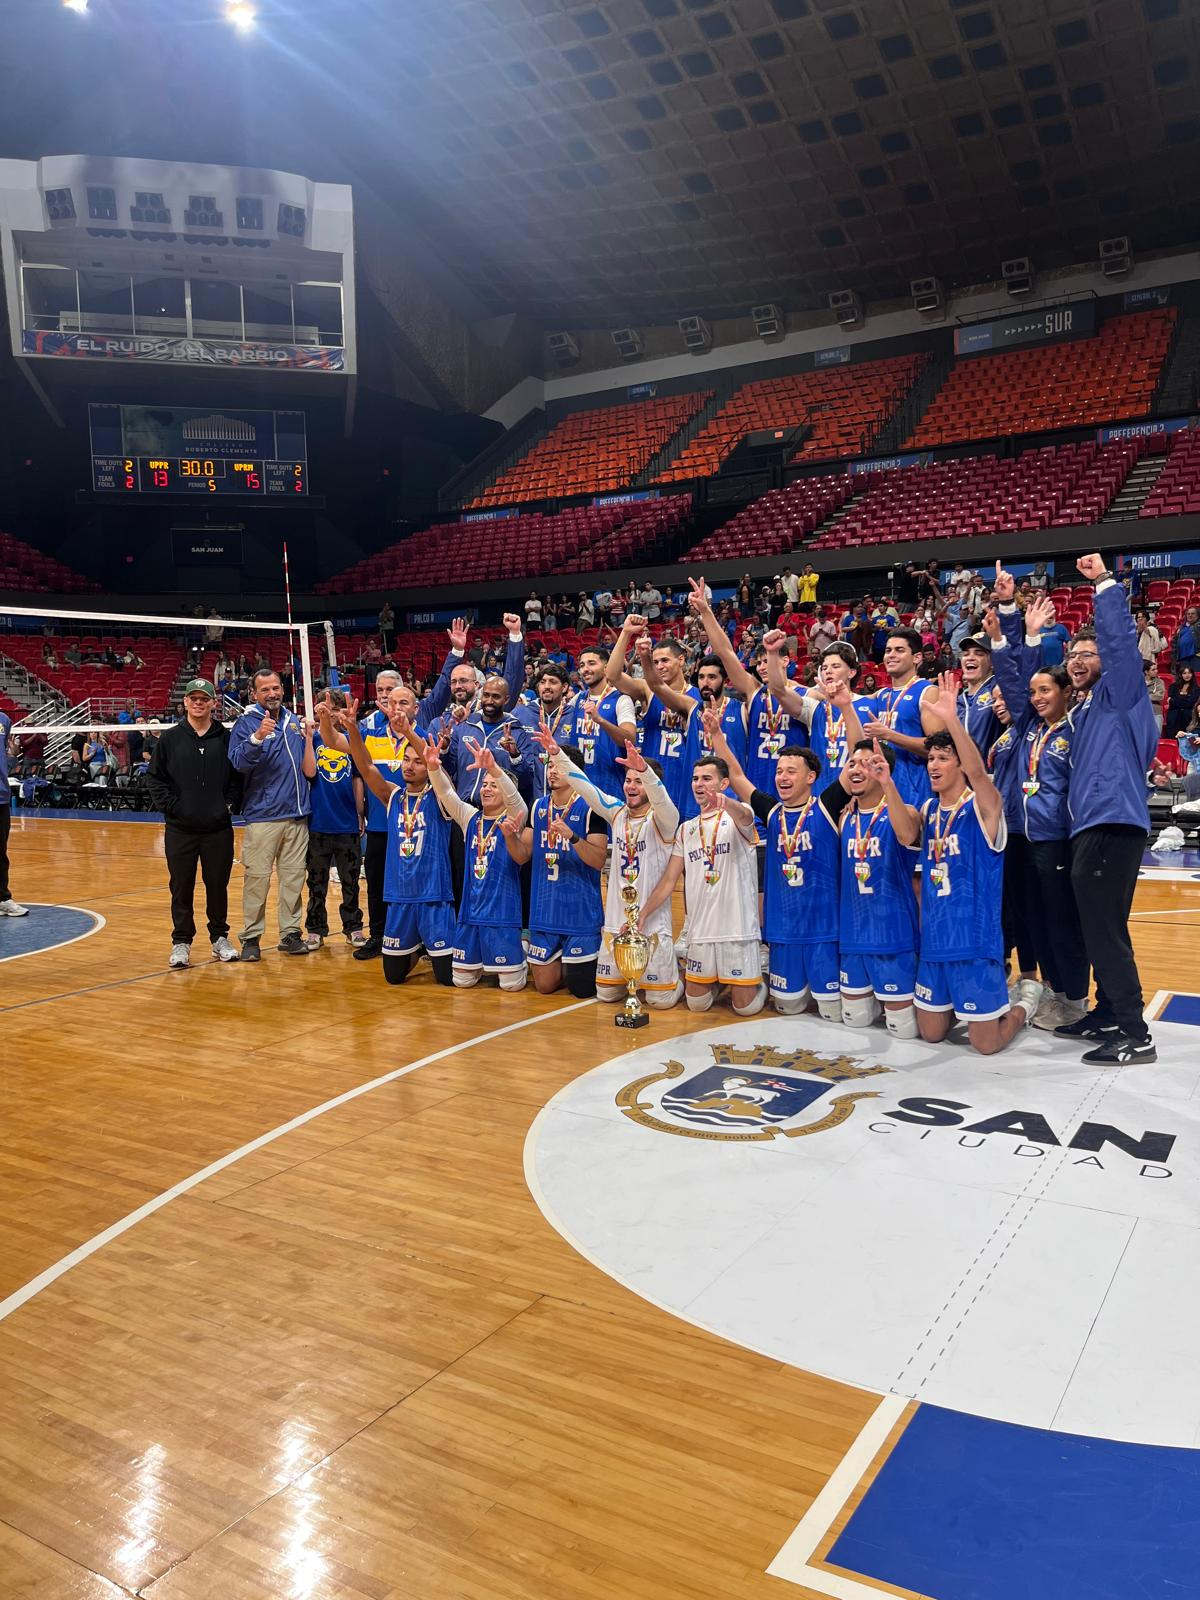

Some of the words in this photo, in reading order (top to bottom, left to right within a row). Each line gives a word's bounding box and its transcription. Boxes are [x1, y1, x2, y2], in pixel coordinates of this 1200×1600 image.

[1045, 310, 1072, 334] SUR
[77, 339, 102, 351] EL
[106, 340, 170, 353] RUIDO
[172, 346, 209, 361] DEL
[213, 347, 289, 361] BARRIO
[185, 446, 219, 454] ROBERTO
[124, 460, 133, 472] 2
[150, 461, 169, 470] UPPR
[182, 460, 214, 476] 30.0
[294, 465, 302, 476] 2
[126, 476, 134, 488] 2
[154, 471, 168, 486] 13
[208, 480, 216, 491] 5
[247, 473, 260, 488] 15
[294, 480, 302, 492] 2
[1132, 557, 1162, 569] PALCO
[1165, 555, 1171, 567] U
[414, 614, 430, 624] PALCO
[576, 718, 600, 736] PUR
[758, 711, 790, 730] PR
[660, 730, 682, 758] 12
[398, 811, 426, 828] PR
[777, 831, 813, 852] PPR
[848, 836, 882, 858] PUR
[928, 834, 960, 860] PPR
[452, 948, 466, 960] UPR
[528, 944, 546, 959] PUPR
[687, 959, 702, 972] UPR
[840, 970, 850, 984] PR
[881, 1097, 1177, 1163] SAN
[868, 1122, 1173, 1179] CIUDAD
